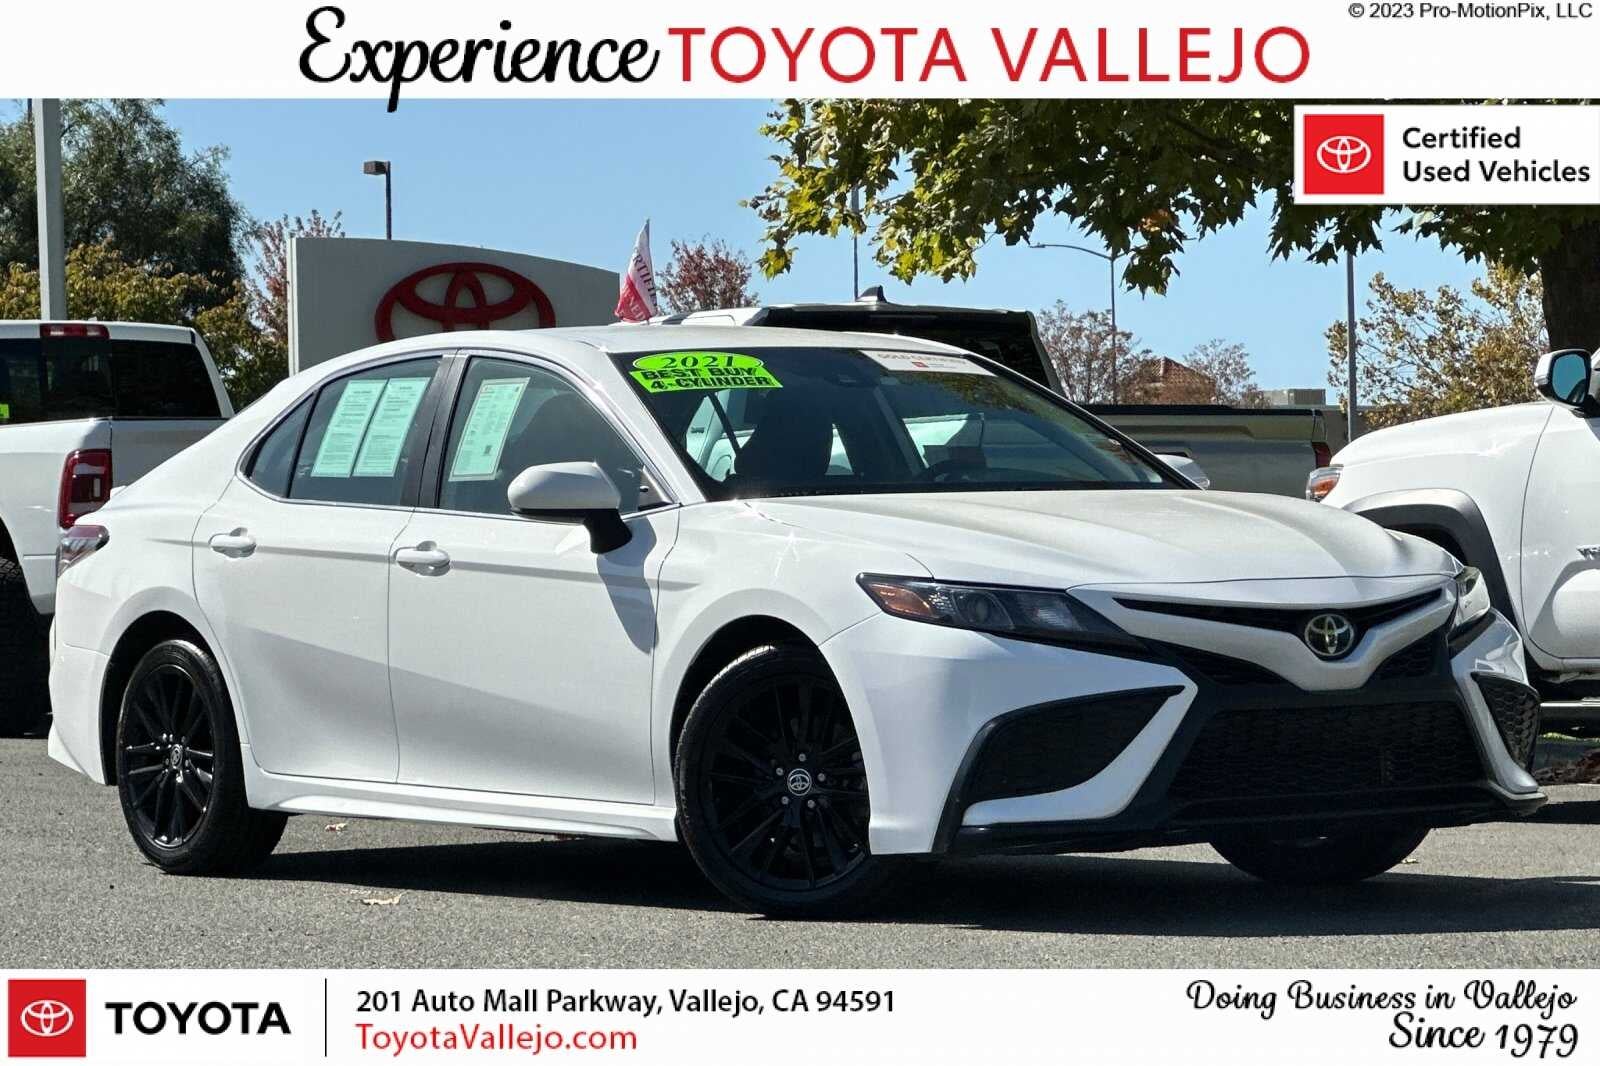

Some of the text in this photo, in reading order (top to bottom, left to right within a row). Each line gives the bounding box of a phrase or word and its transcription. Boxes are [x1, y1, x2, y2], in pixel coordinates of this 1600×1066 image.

[660, 355, 734, 369] 2021
[640, 367, 757, 380] BEST BUY
[650, 376, 772, 390] 4-CYLINDER
